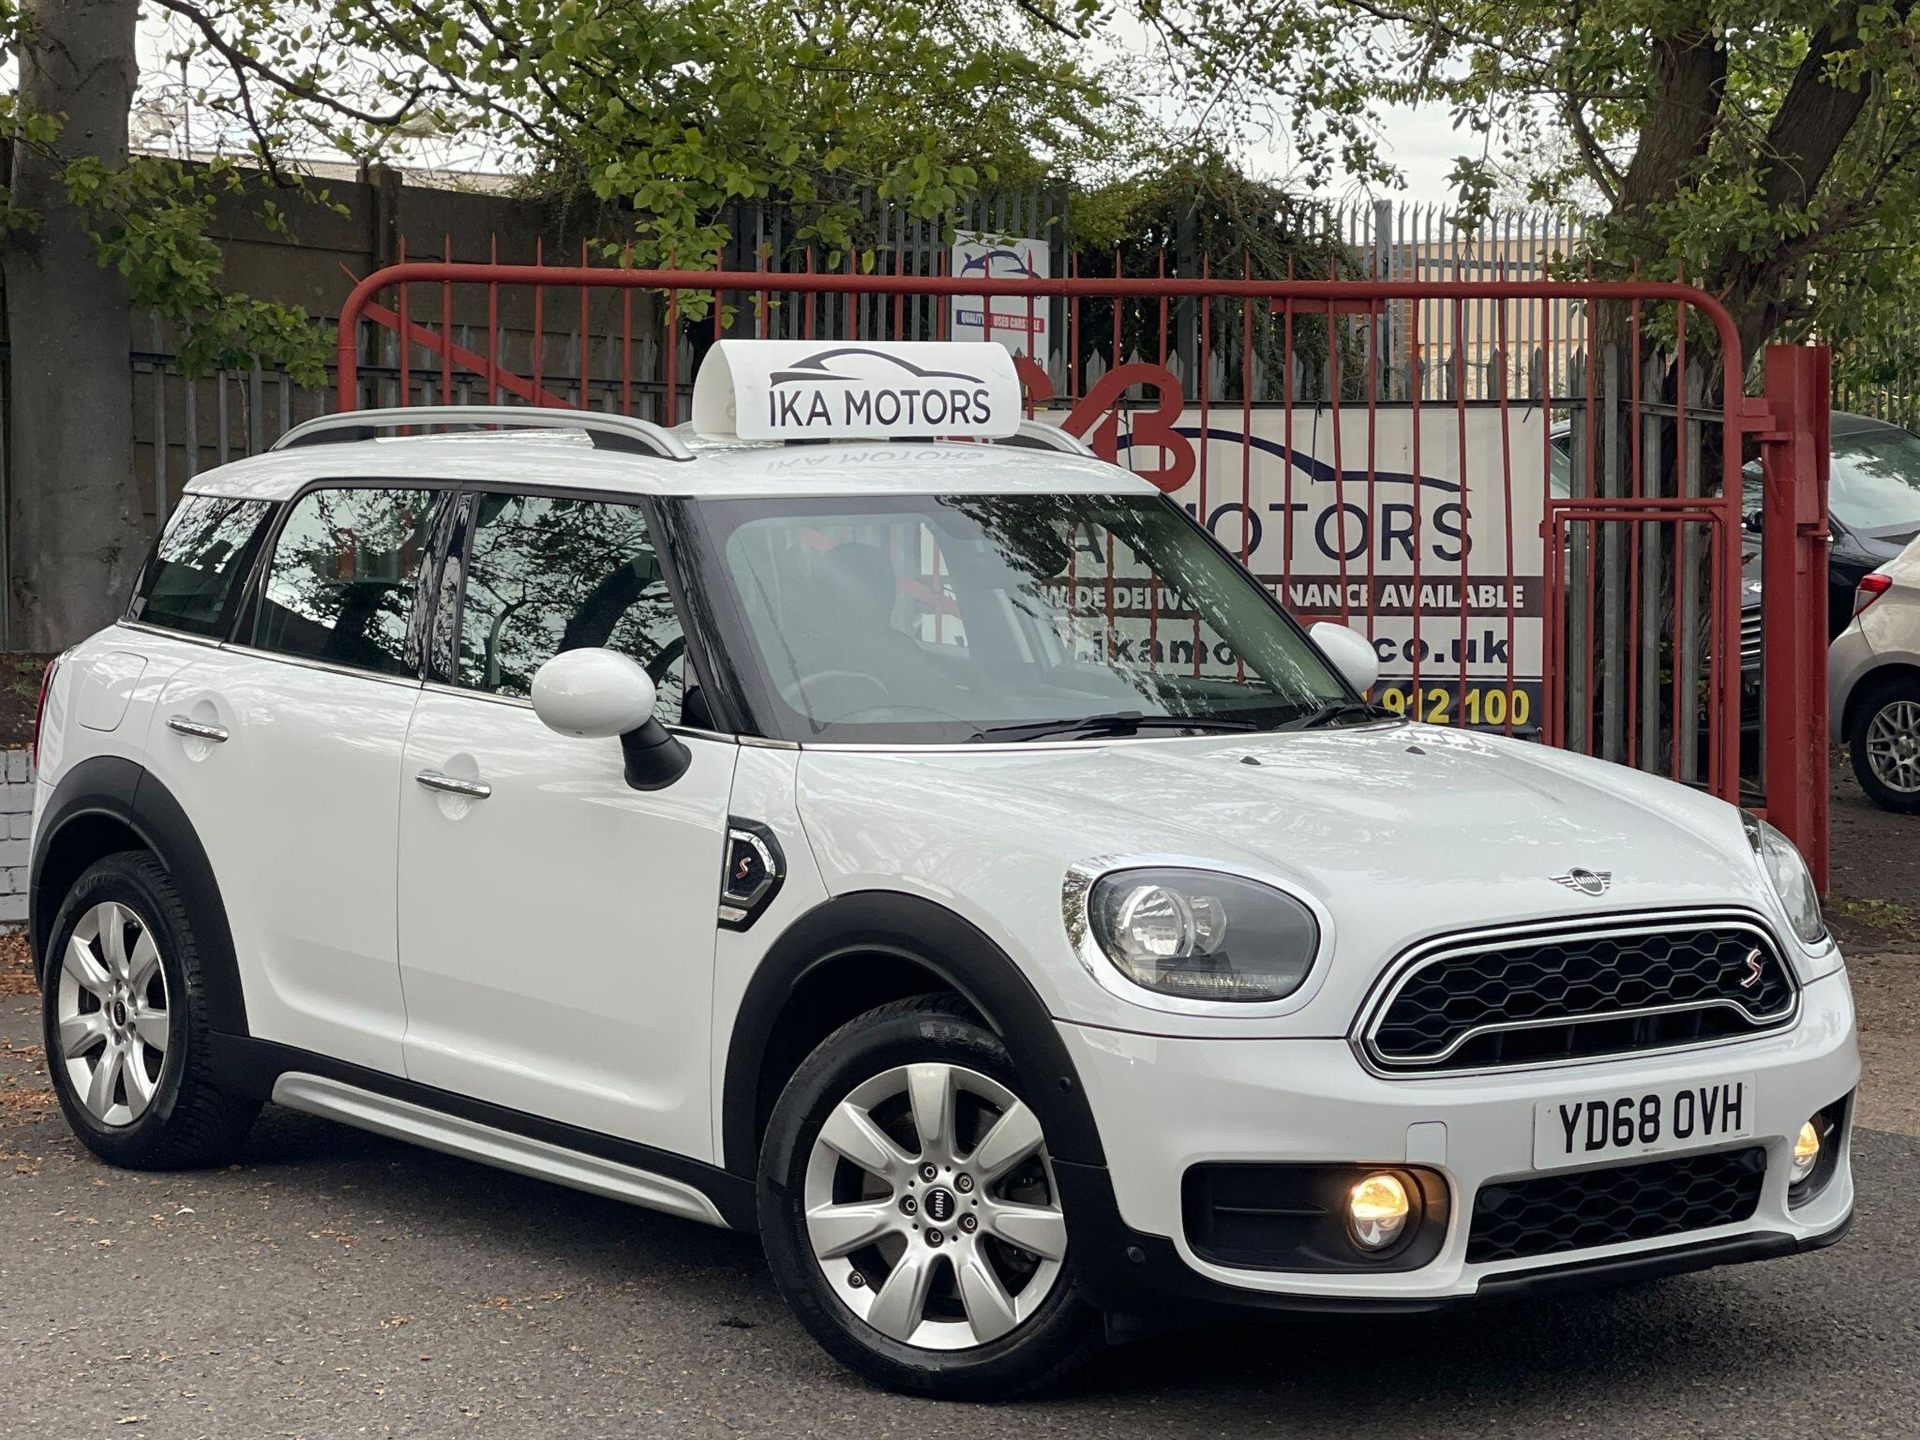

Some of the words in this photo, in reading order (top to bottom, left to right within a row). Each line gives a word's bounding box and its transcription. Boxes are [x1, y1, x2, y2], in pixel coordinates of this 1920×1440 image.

[993, 315, 1009, 328] USED
[769, 389, 832, 427] IKA
[844, 388, 991, 426] MOTORS
[1185, 502, 1474, 563] OTORS
[1380, 585, 1524, 608] AVAILABLE
[1465, 688, 1530, 725] 100
[1575, 876, 1600, 885] MINI
[1559, 1094, 1662, 1154] YD68
[1673, 1082, 1743, 1139] OVH
[935, 1192, 945, 1218] MINI
